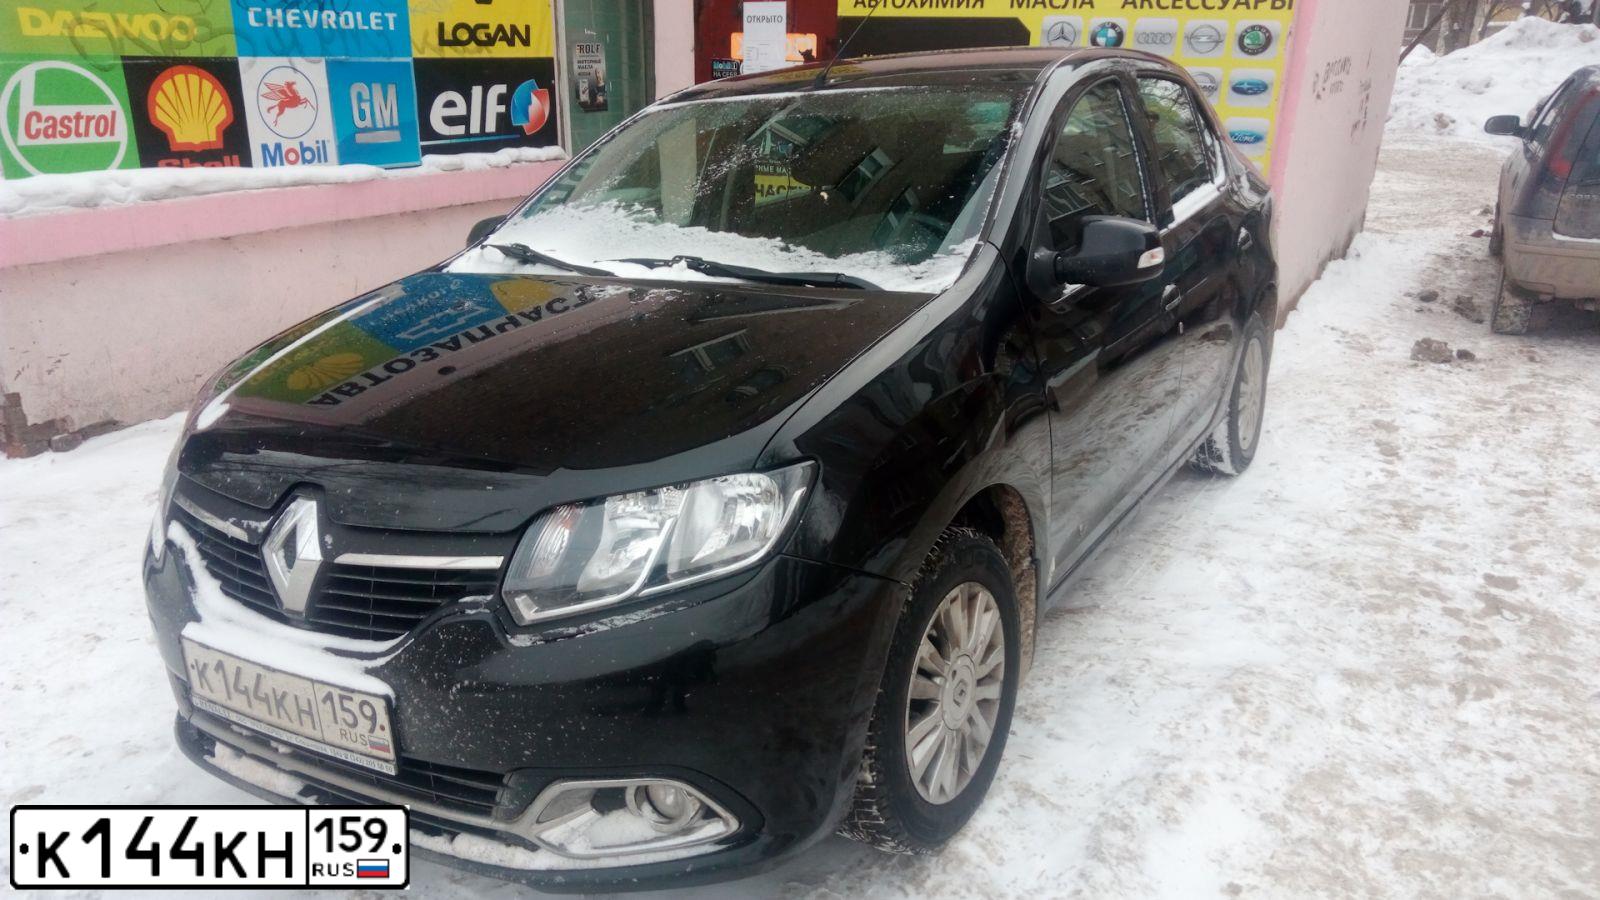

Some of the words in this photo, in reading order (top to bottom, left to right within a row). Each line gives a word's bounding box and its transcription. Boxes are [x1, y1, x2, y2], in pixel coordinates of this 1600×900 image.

[17, 7, 197, 41] DAEWOO
[248, 8, 397, 31] CHEVROLET
[746, 15, 784, 24] ОТКРЫТО
[438, 22, 531, 47] LOGAN
[579, 44, 601, 54] ROLF
[351, 82, 399, 129] GM
[429, 84, 508, 136] elf
[24, 110, 117, 141] Castrol
[260, 139, 329, 167] Mobil
[321, 690, 378, 734] 159
[339, 727, 369, 747] RUS
